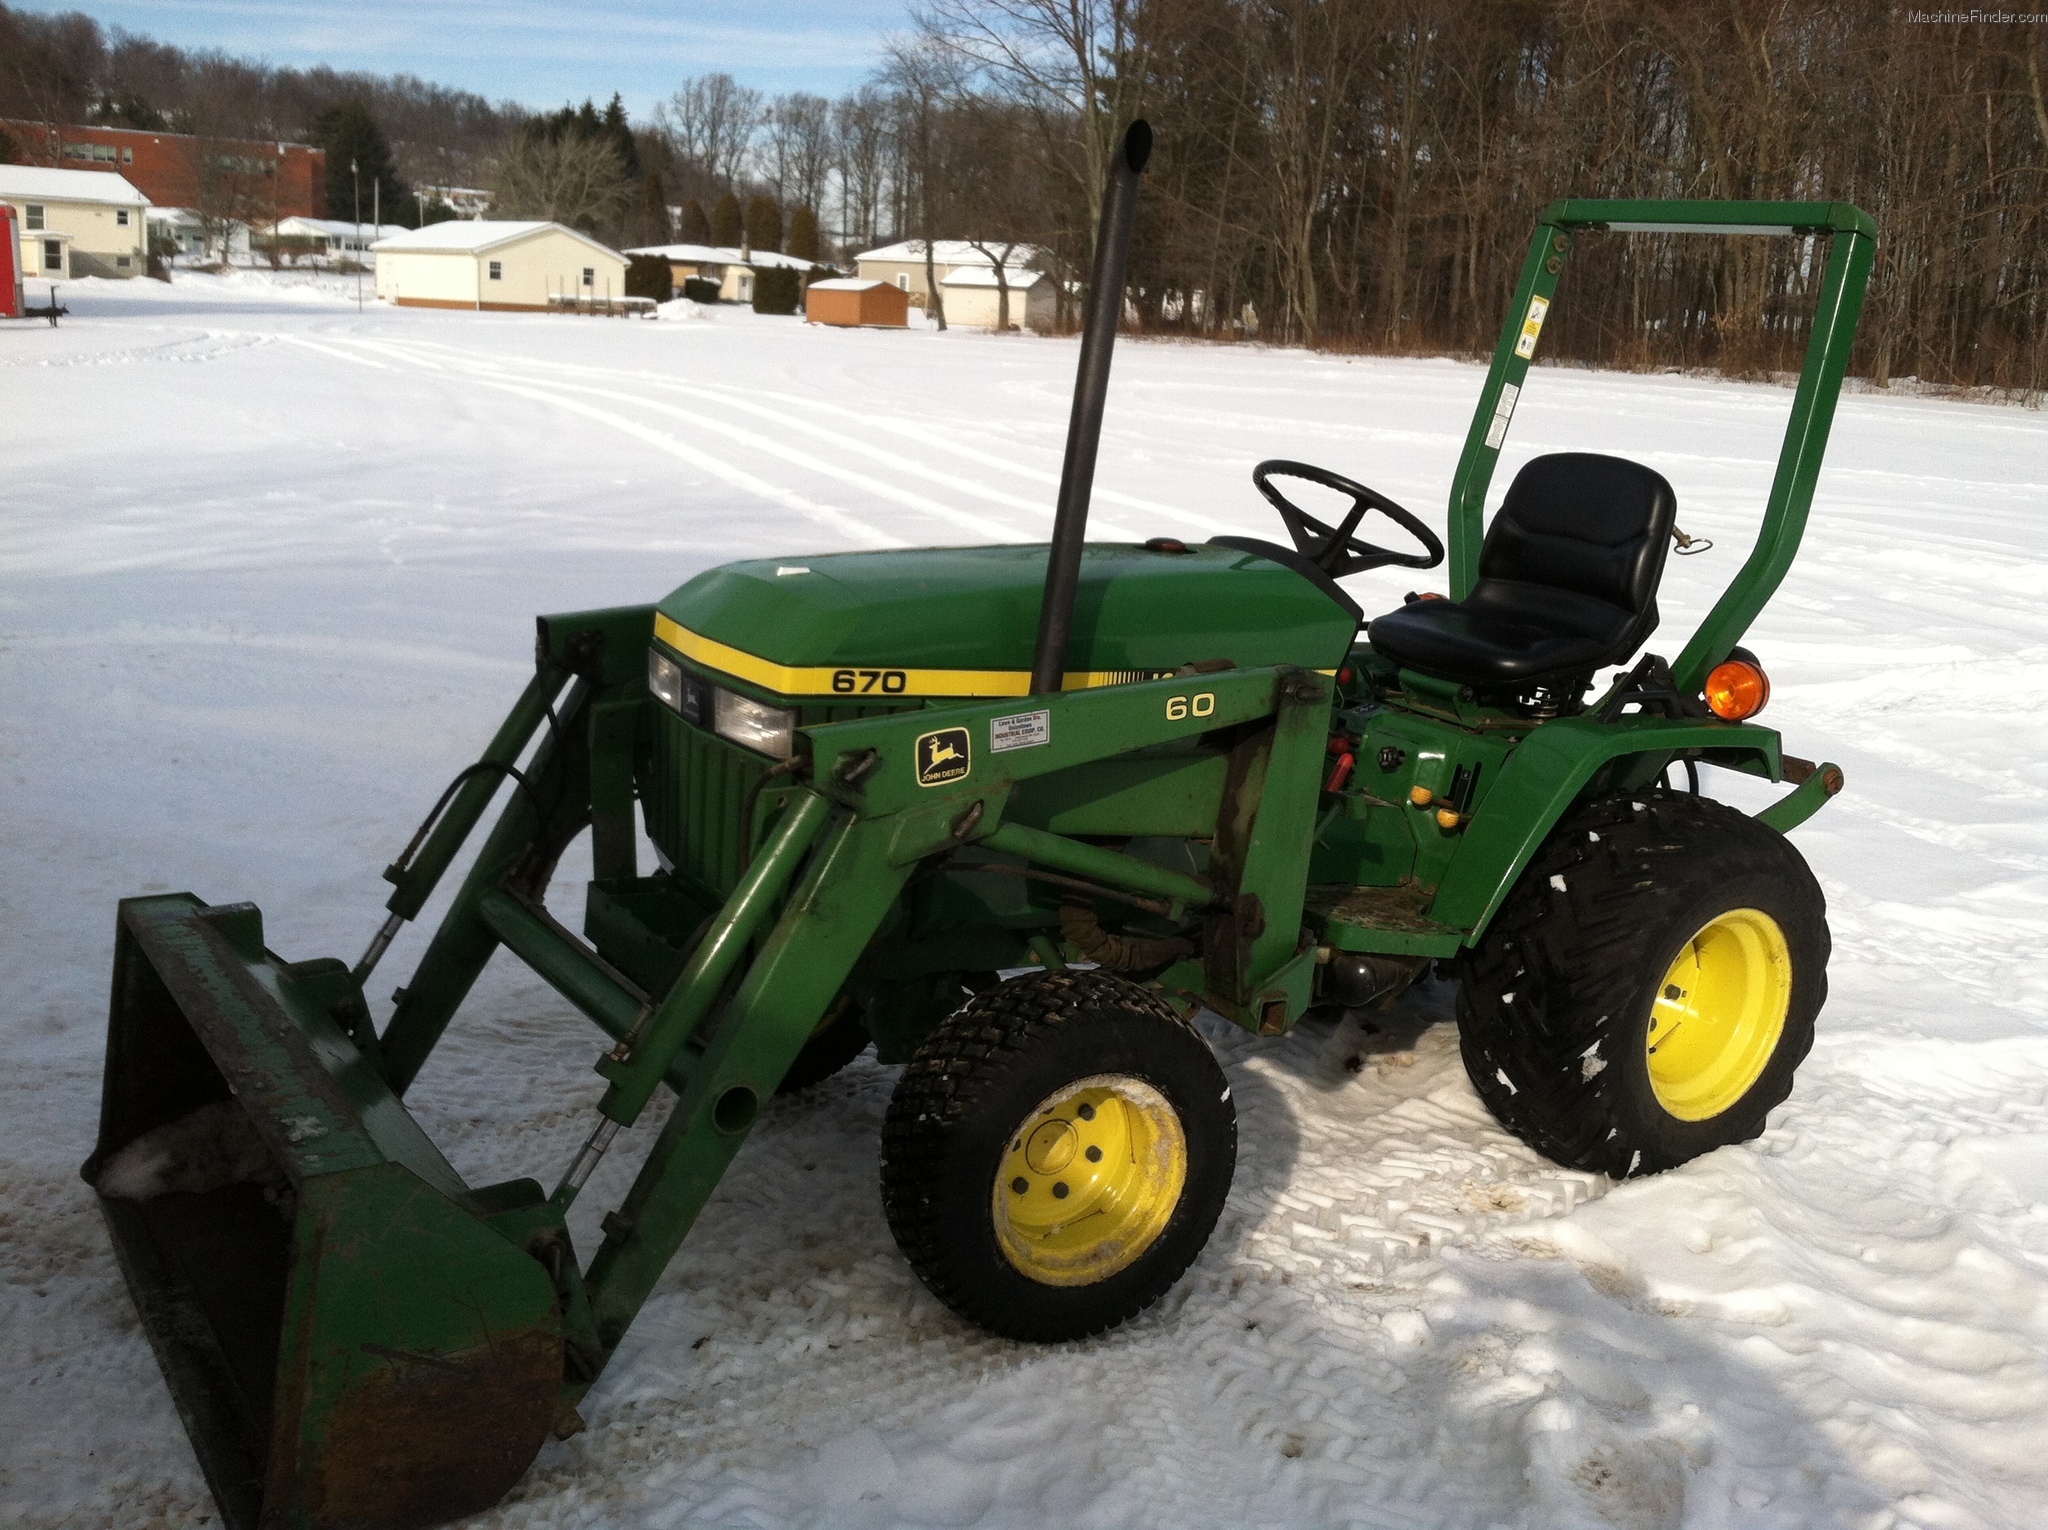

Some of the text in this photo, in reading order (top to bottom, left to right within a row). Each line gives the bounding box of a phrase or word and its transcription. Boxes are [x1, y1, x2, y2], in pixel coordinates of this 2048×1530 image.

[832, 670, 907, 694] 670
[1166, 692, 1215, 721] 60
[995, 730, 1021, 739] INDUSTRIAL
[921, 767, 965, 782] JOHN DEERE
